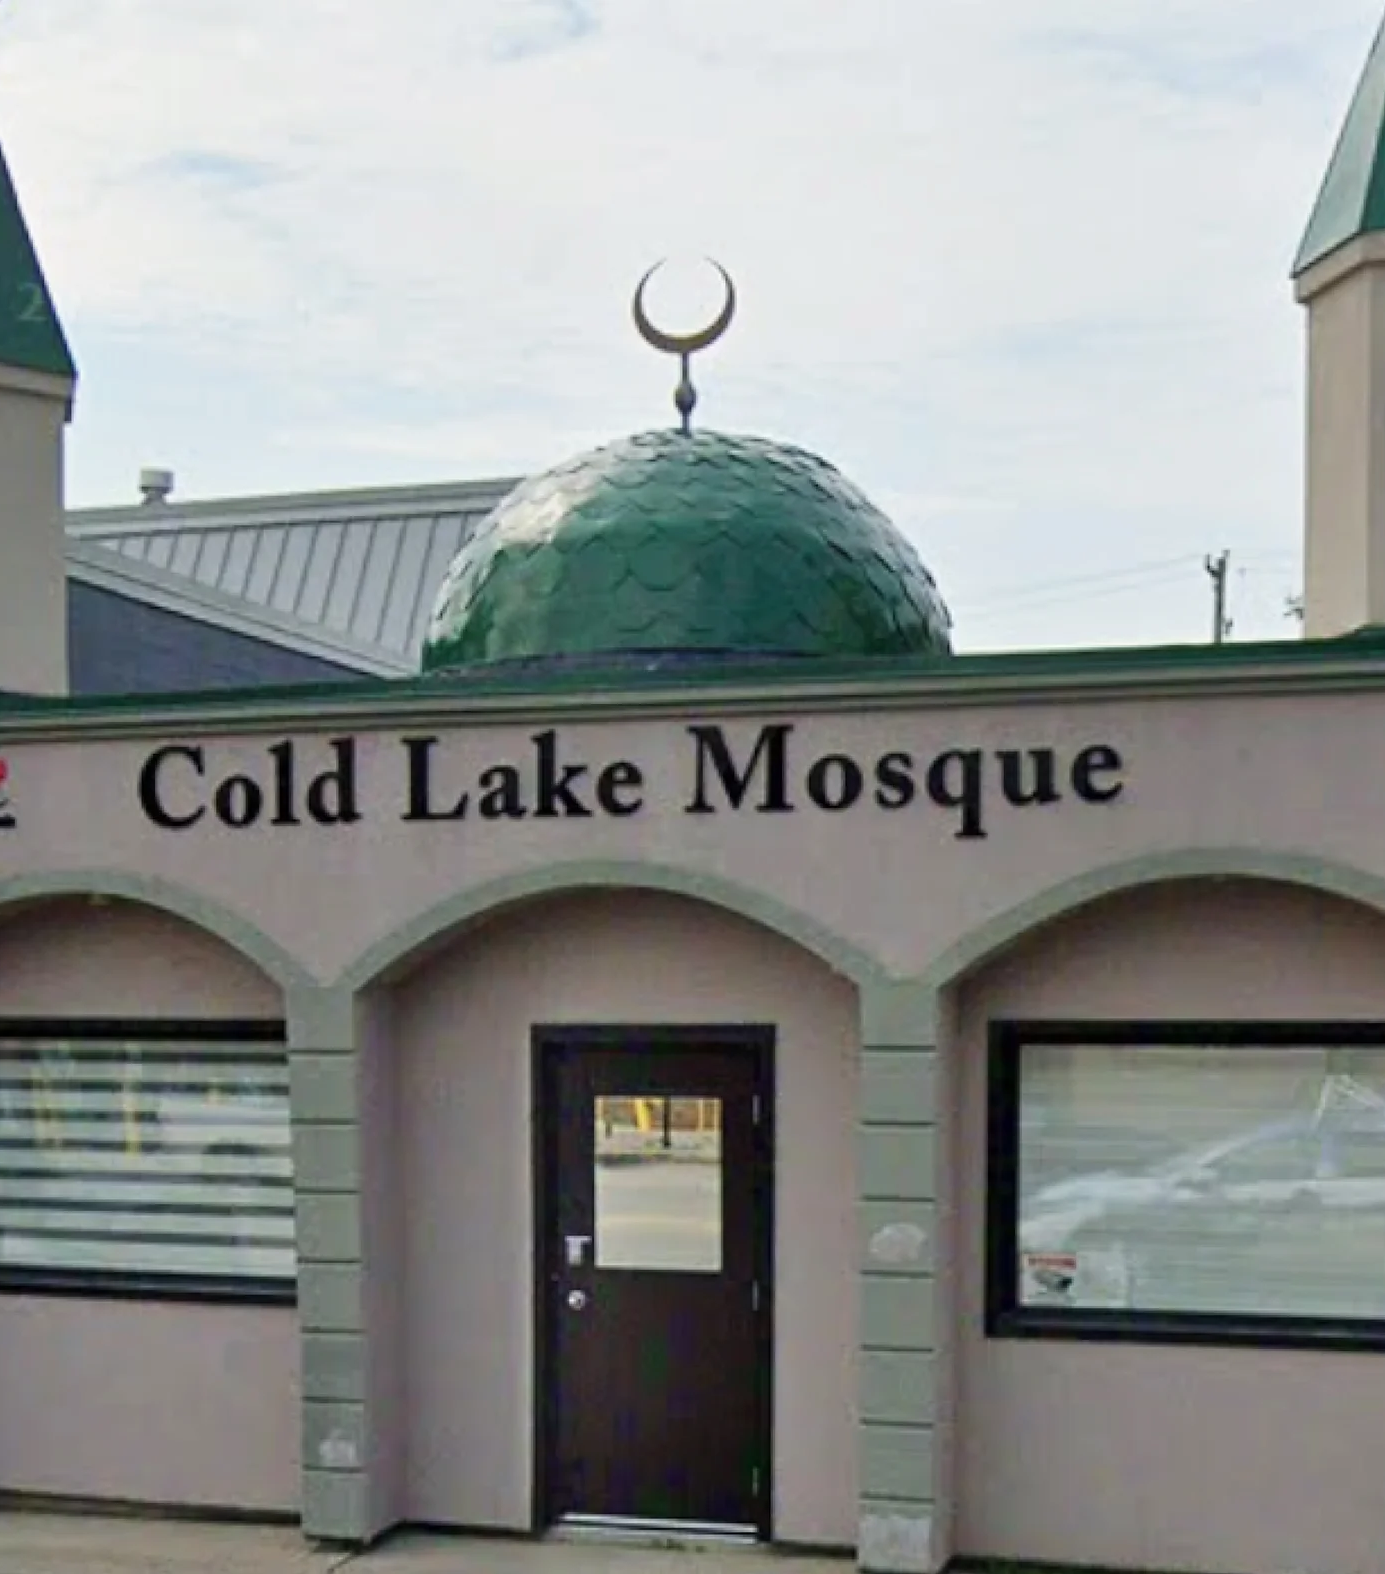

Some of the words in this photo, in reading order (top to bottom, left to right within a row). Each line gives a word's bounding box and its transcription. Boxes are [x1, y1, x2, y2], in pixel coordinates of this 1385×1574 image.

[138, 738, 362, 831] Cold
[399, 728, 643, 824] Lake
[685, 723, 1124, 840] Mosque
